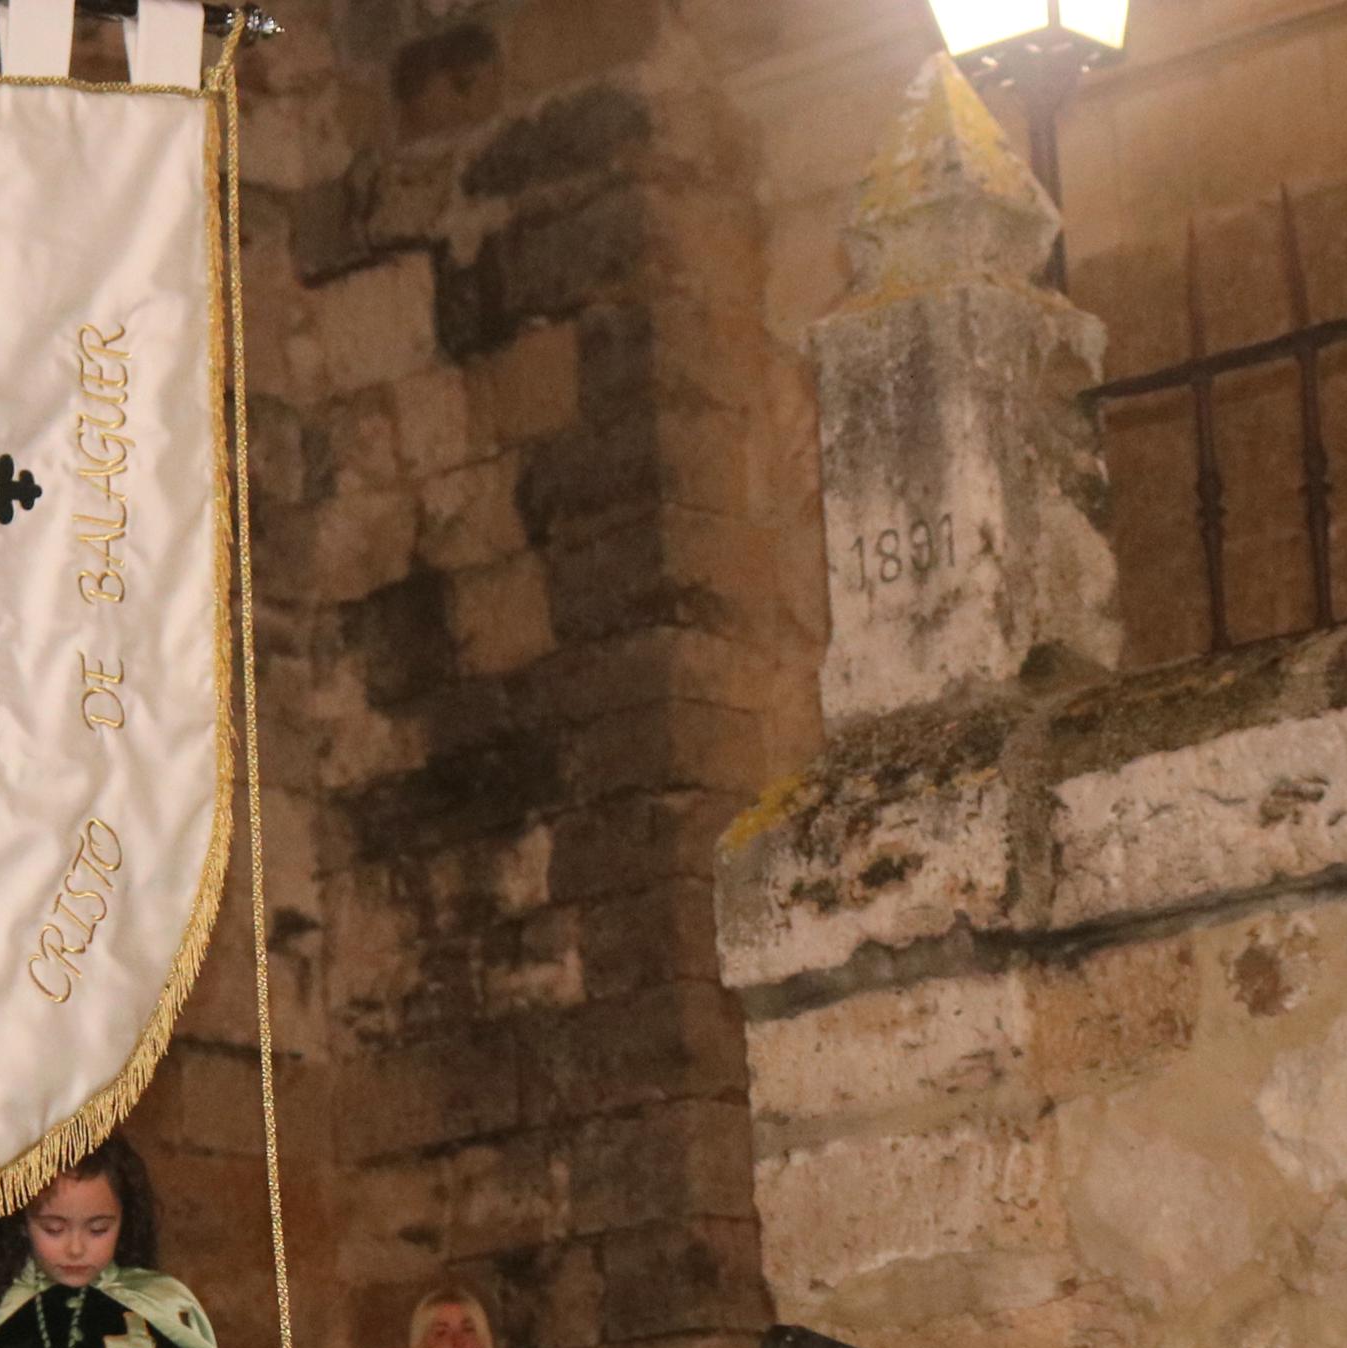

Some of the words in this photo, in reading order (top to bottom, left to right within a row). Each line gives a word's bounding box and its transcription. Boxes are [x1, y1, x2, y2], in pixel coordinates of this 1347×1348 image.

[72, 322, 136, 605] BALAGUER
[77, 650, 125, 731] DE
[27, 817, 122, 1003] CRISTO
